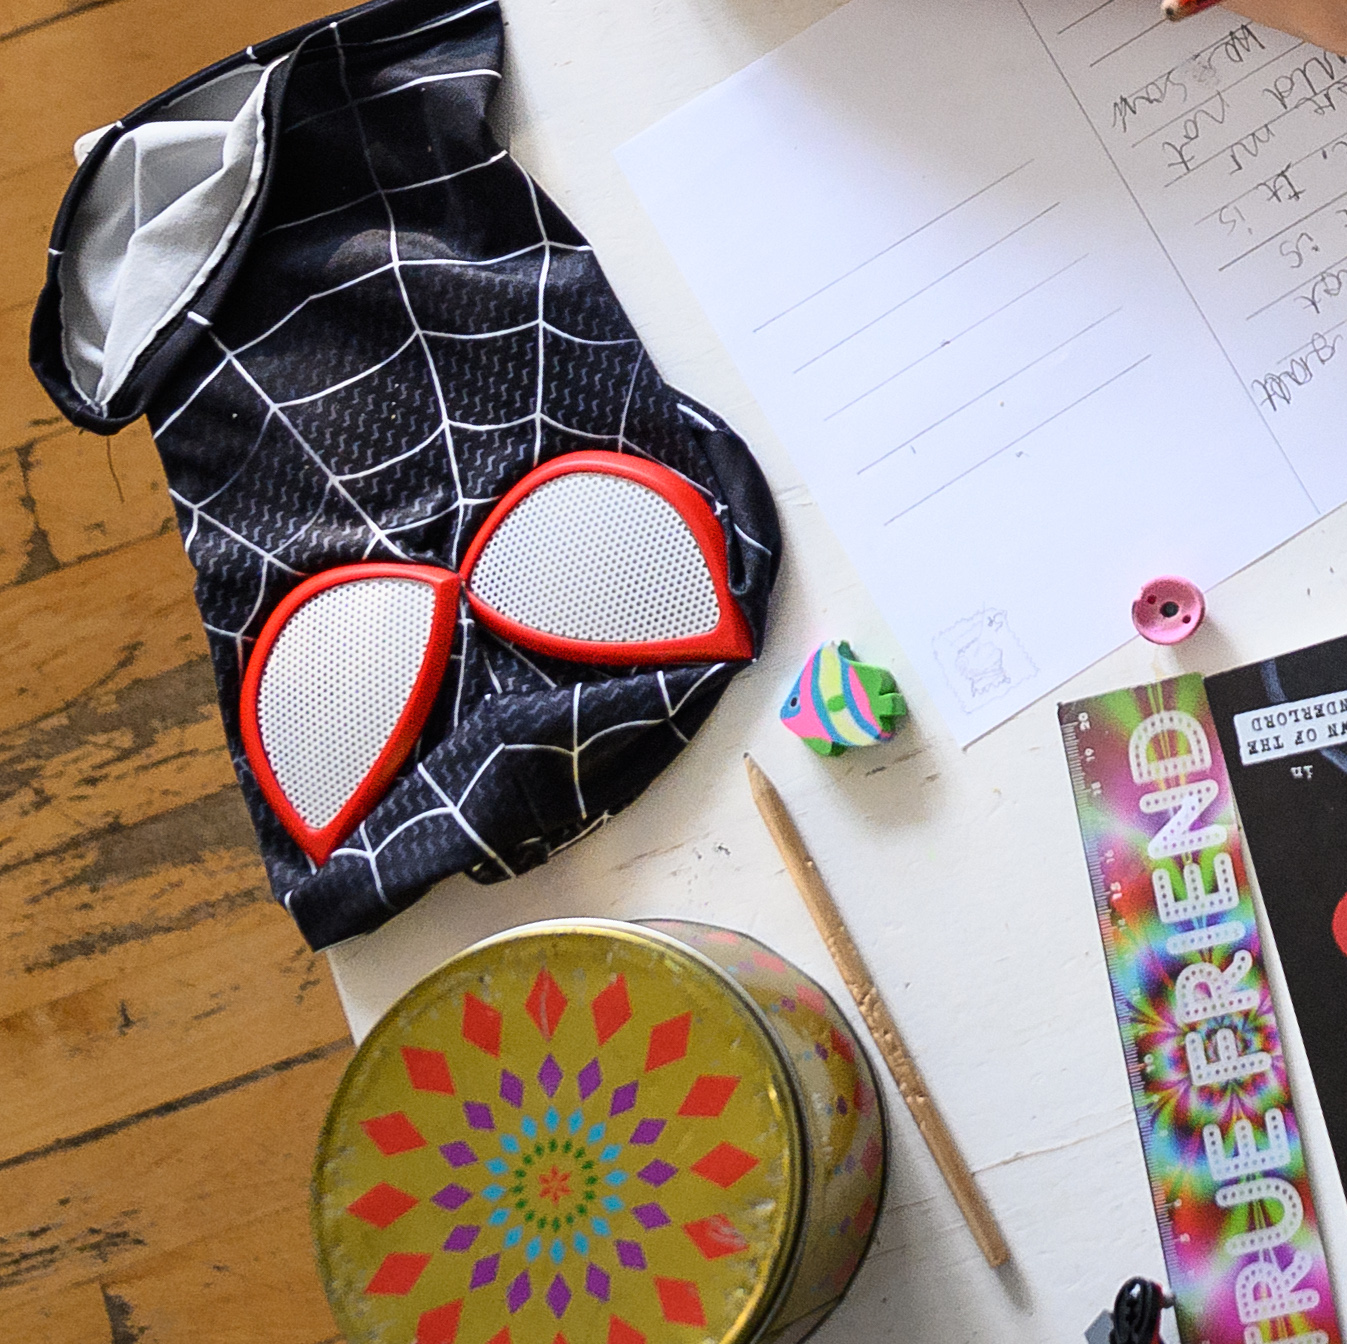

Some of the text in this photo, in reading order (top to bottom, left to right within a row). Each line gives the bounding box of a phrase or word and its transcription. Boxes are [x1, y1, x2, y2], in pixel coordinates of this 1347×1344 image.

[1161, 90, 1229, 172] not
[1218, 205, 1252, 236] is
[1278, 231, 1319, 269] is
[1077, 711, 1090, 731] 20
[1246, 734, 1284, 755] THE
[1293, 727, 1317, 746] OF
[1083, 747, 1095, 762] 19
[1289, 764, 1313, 779] in
[1109, 880, 1122, 901] 15
[1129, 711, 1272, 1087] FRIEND
[1143, 1053, 1156, 1072] 10
